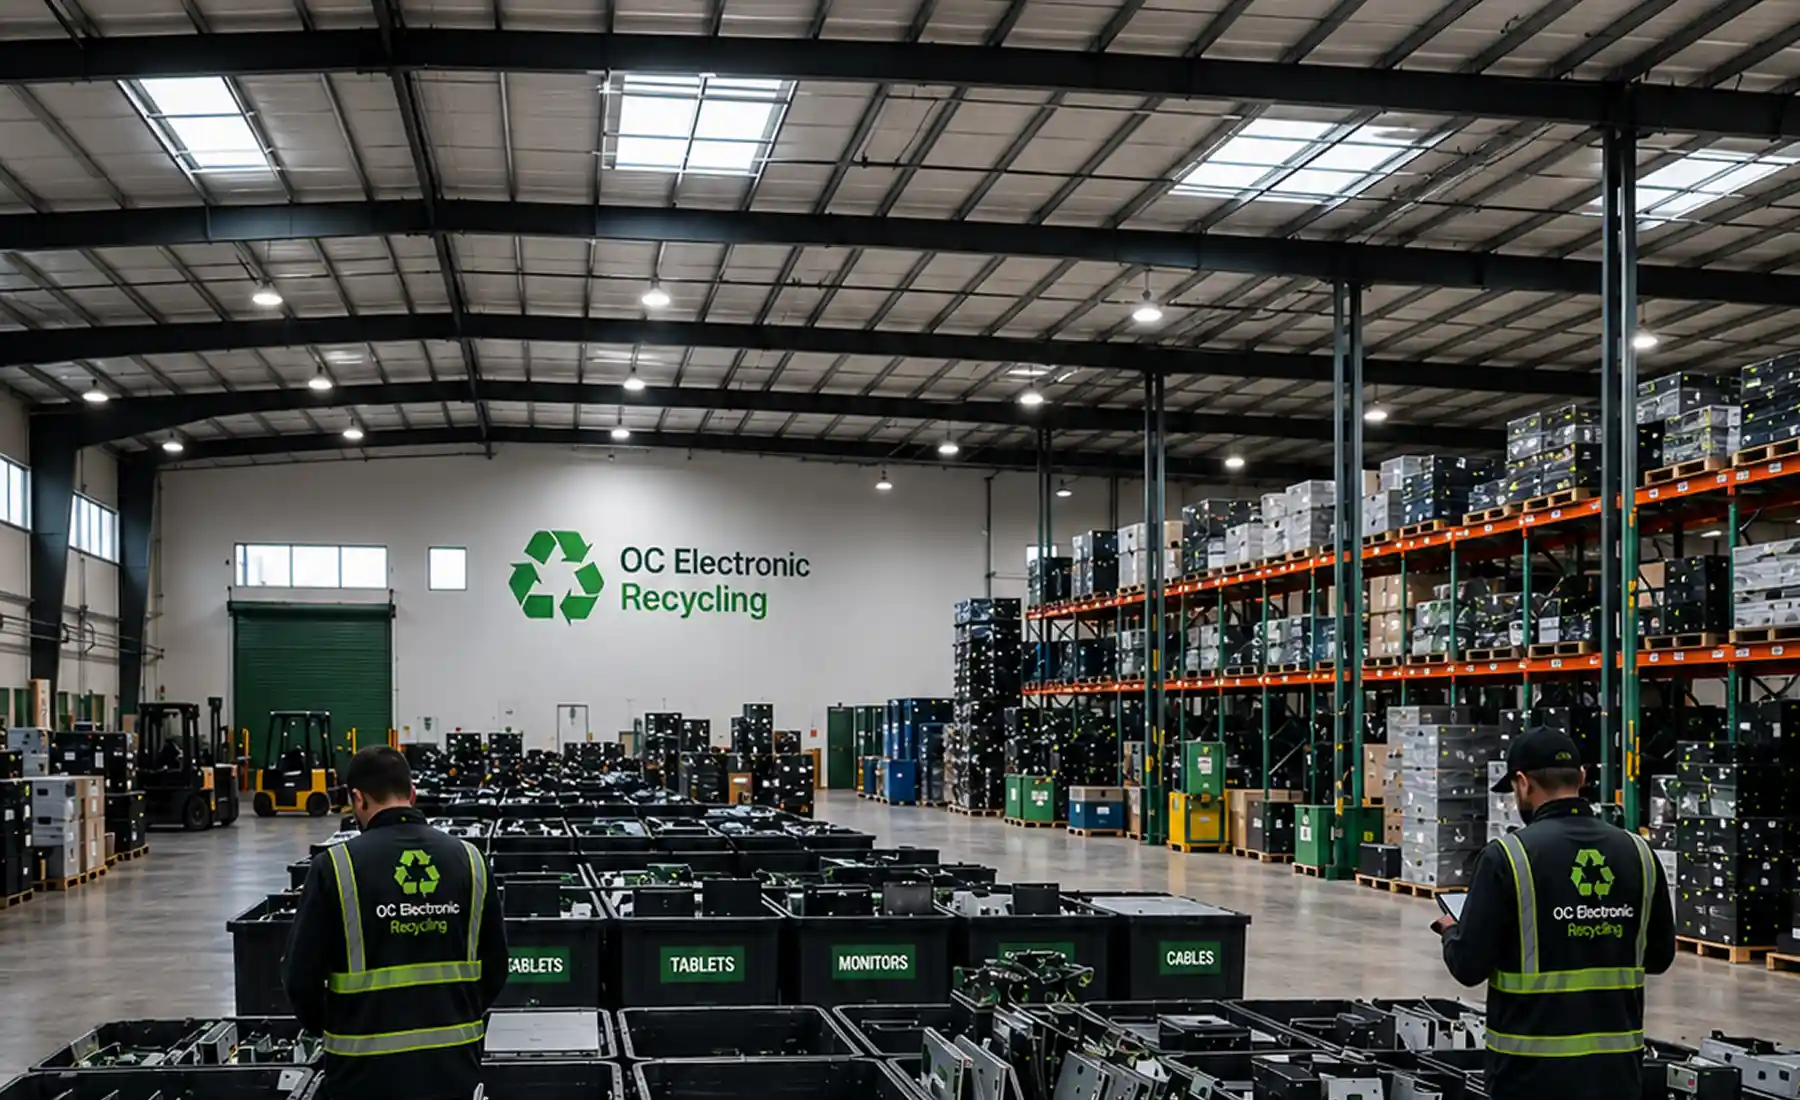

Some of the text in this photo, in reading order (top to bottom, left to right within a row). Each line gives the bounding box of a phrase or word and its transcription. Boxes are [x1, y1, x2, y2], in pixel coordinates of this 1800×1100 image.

[620, 547, 811, 577] OC Electronic
[621, 582, 768, 620] Recycling
[376, 901, 460, 918] OC Electronic
[1553, 906, 1575, 921] OC
[670, 956, 736, 973] TABLETS
[838, 954, 909, 971] MONITORS
[1166, 950, 1215, 966] CABLES
